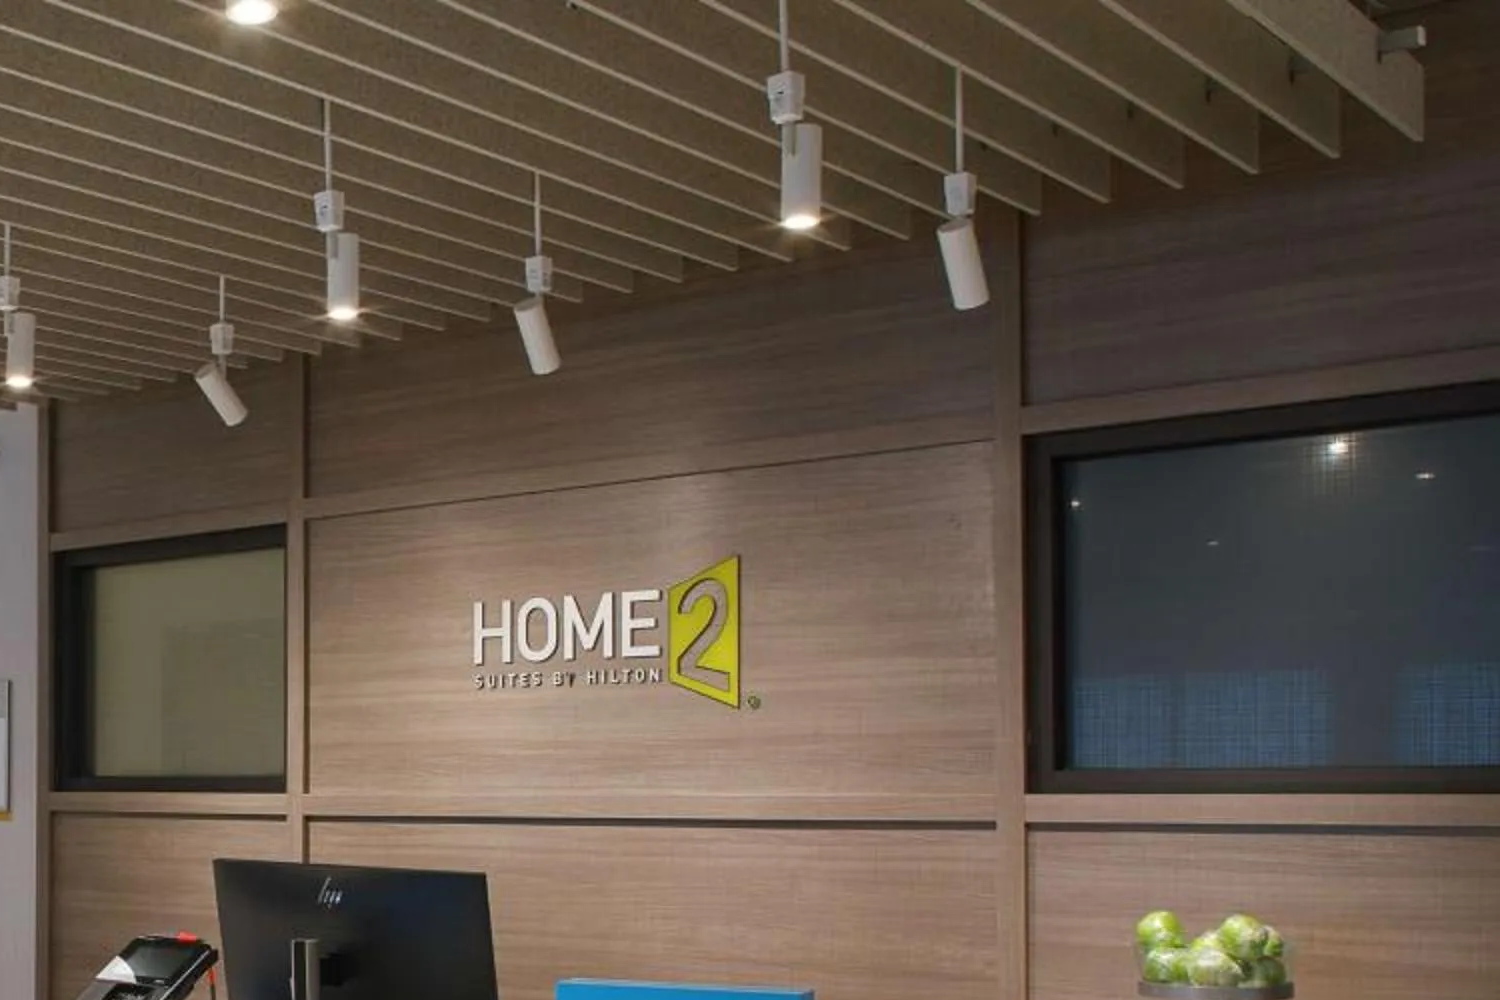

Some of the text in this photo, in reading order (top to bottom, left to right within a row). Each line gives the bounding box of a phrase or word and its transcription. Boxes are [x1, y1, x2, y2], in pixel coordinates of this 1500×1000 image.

[473, 588, 663, 665] HOME
[473, 668, 662, 690] SUITES BY HILTON
